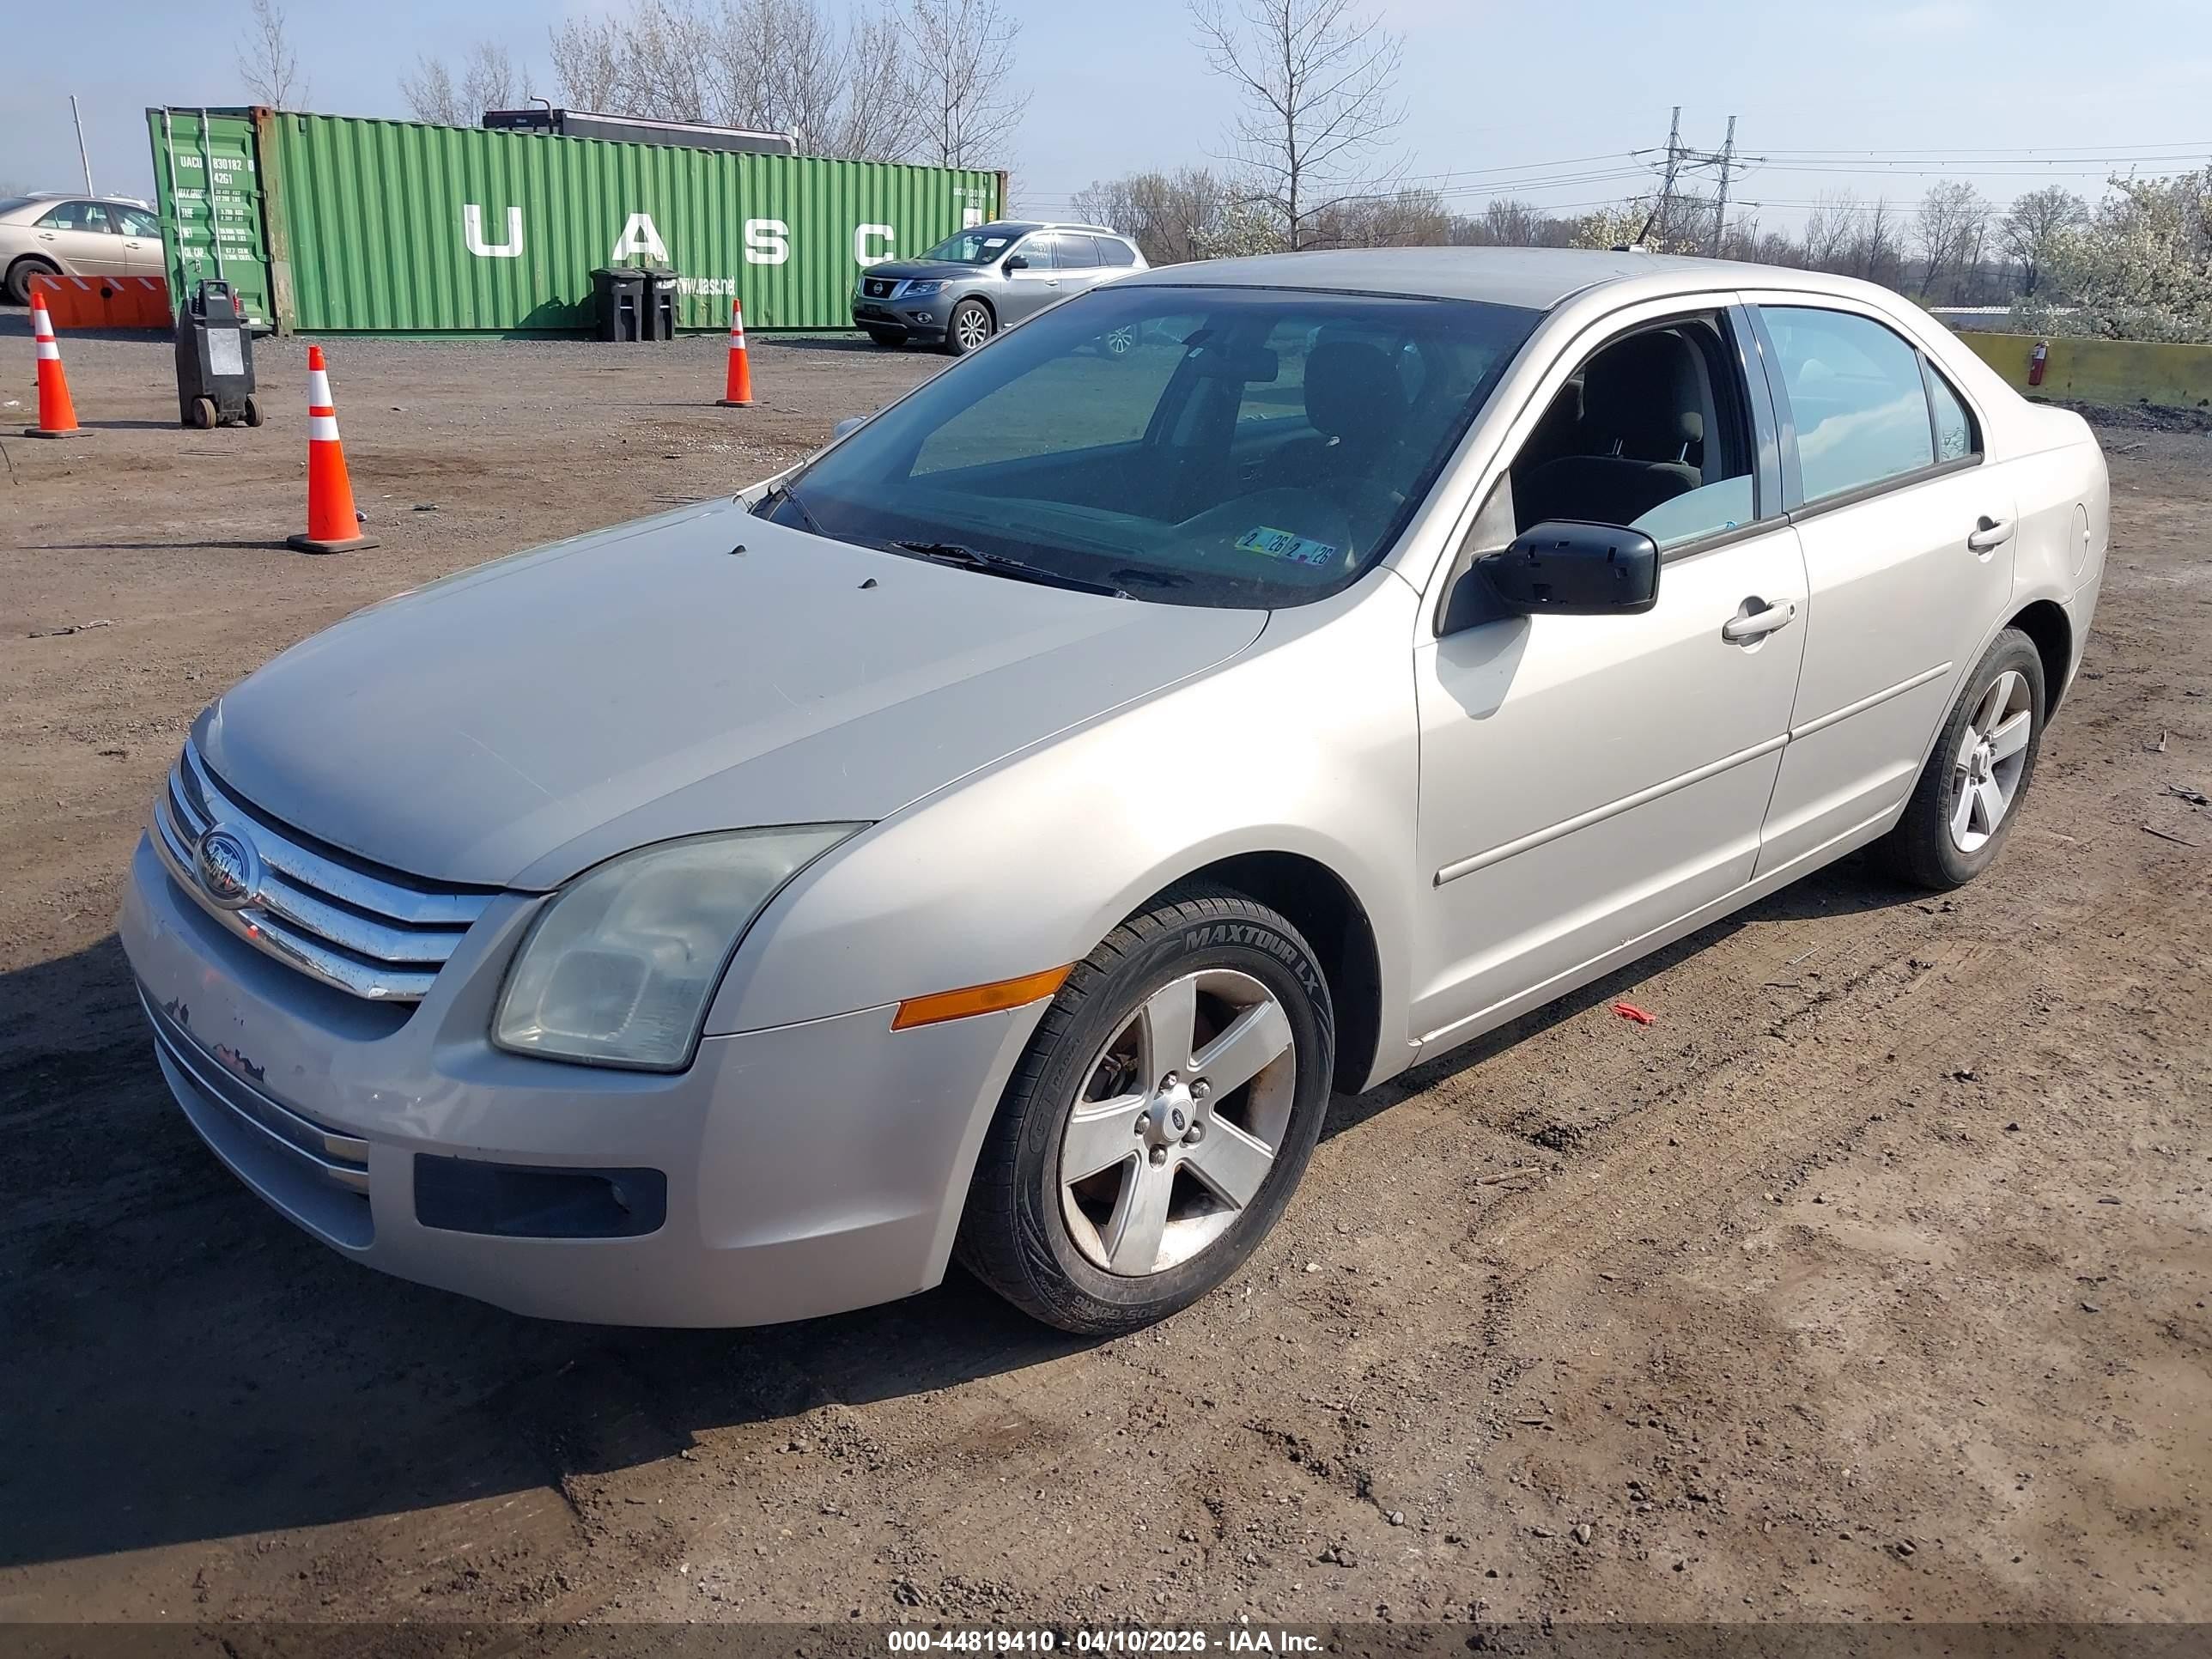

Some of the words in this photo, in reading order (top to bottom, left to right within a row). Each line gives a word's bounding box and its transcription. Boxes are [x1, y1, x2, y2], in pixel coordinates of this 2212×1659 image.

[180, 156, 203, 168] UACU
[212, 157, 241, 171] 830182
[214, 173, 233, 184] 42G1
[677, 275, 736, 295] www.uasc.net
[1186, 925, 1297, 964] MAXTOUR
[1294, 960, 1319, 995] LX
